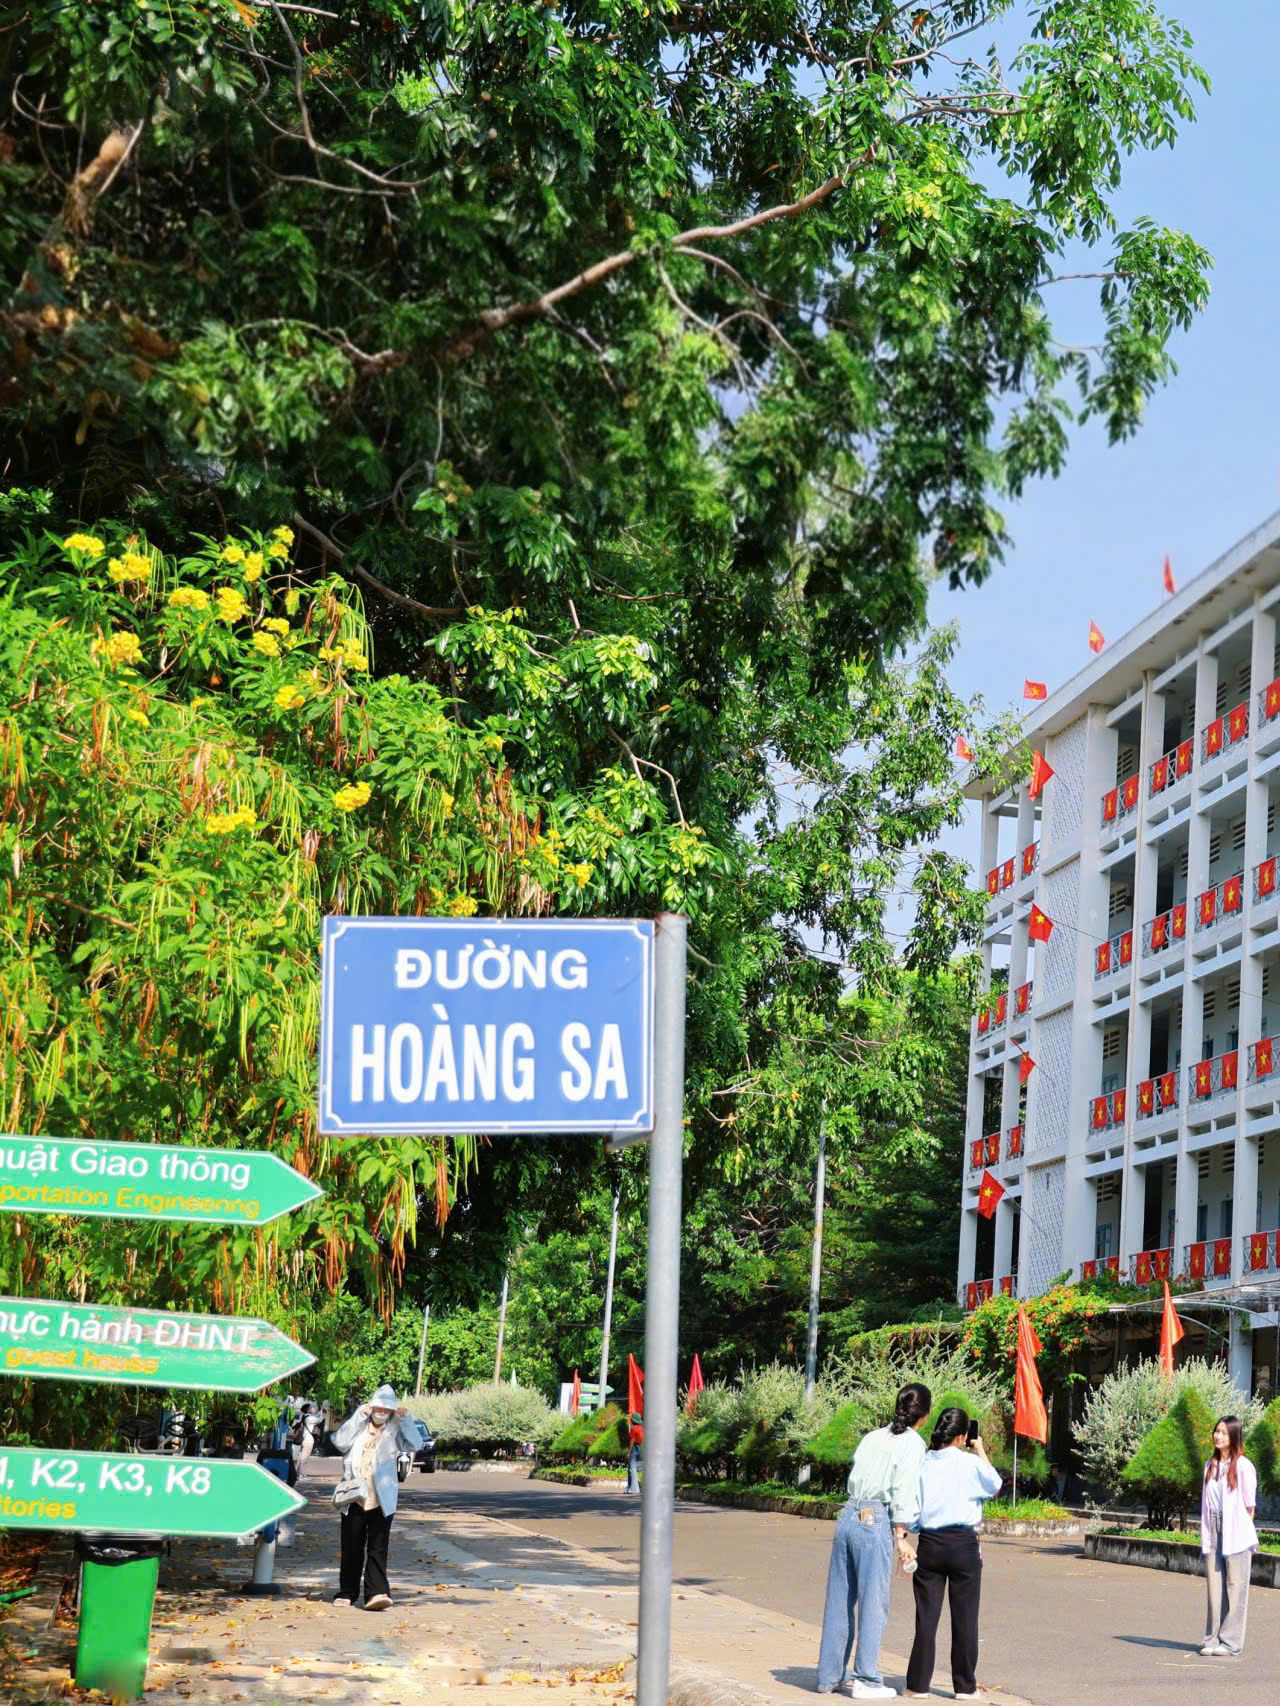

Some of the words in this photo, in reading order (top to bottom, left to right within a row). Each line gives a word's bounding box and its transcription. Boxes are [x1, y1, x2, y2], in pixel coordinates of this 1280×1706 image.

[395, 938, 588, 990] ĐƯỜNG
[350, 1002, 536, 1104] HOÀNG
[560, 1021, 630, 1102] SA
[70, 1146, 149, 1177] Giao
[160, 1153, 251, 1190] thông
[116, 1186, 260, 1219] Engineering
[59, 1311, 143, 1345] hành
[154, 1319, 257, 1353] ĐHNT
[5, 1346, 76, 1369] guest
[82, 1350, 159, 1374] house
[31, 1457, 86, 1493] K2,
[99, 1461, 153, 1496] K3,
[165, 1465, 212, 1495] K8
